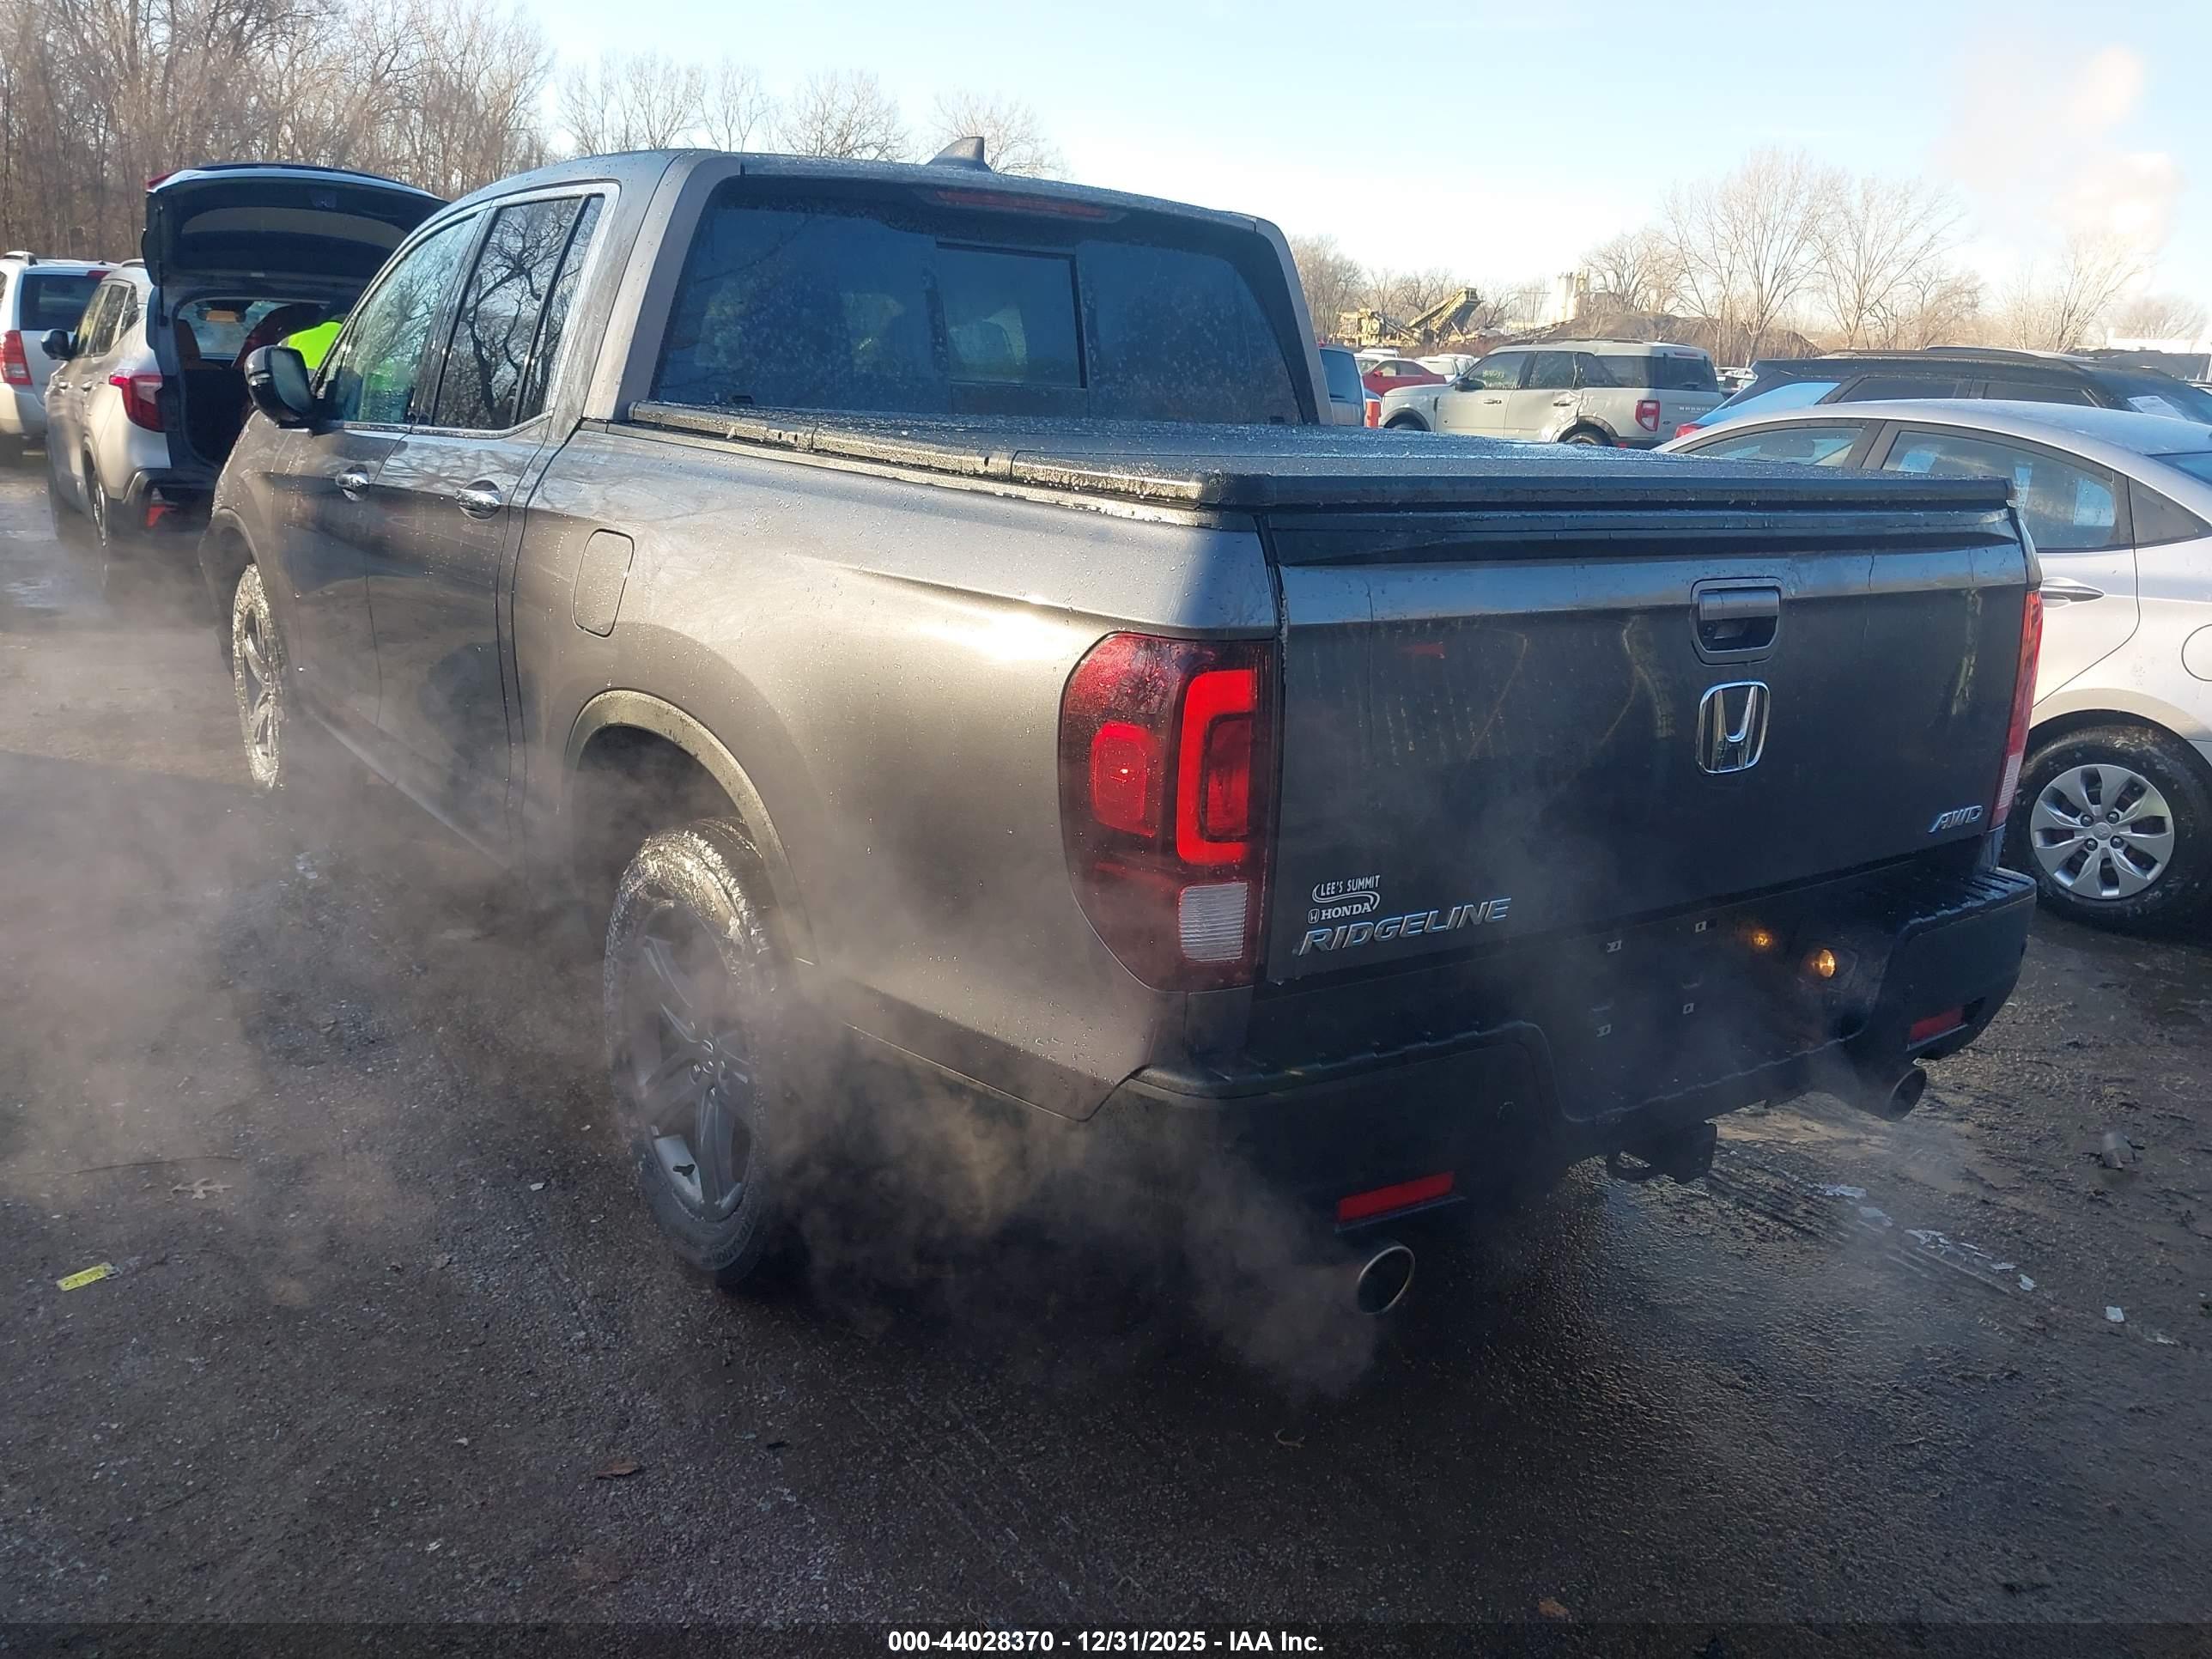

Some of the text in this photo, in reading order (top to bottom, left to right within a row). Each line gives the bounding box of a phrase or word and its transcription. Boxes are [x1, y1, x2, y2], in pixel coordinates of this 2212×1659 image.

[1928, 805, 1983, 833] AWD
[1320, 874, 1380, 896] LEE'S SUMMIT
[1321, 902, 1372, 921] HONDA
[1295, 897, 1511, 956] RIDGELINE
